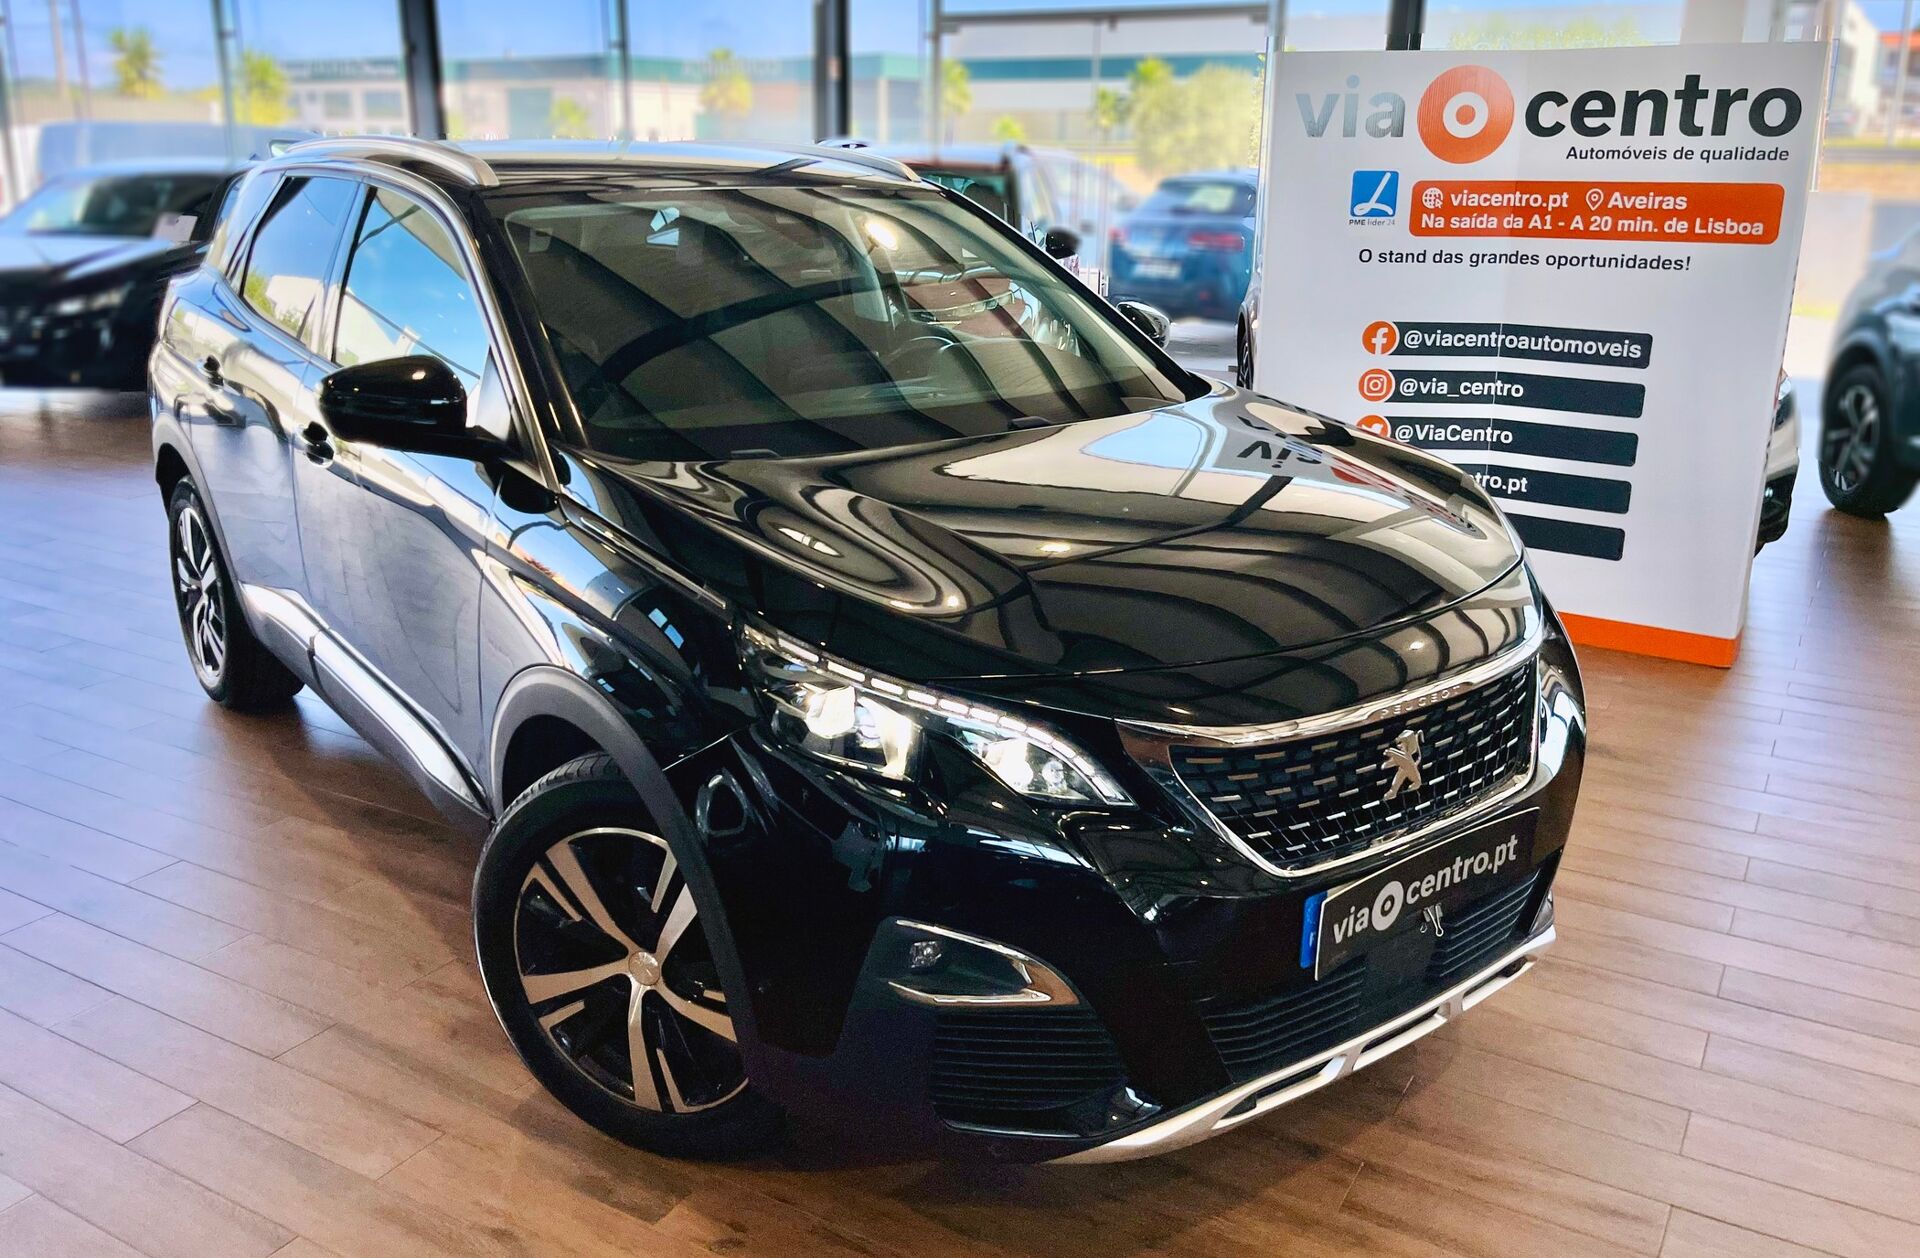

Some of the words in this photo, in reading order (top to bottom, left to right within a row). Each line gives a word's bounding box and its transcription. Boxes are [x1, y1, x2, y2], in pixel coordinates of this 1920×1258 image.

[1295, 74, 1406, 138] via
[1525, 74, 1802, 137] centro
[1566, 145, 1667, 160] Automóveis
[1673, 147, 1694, 160] de
[1700, 147, 1789, 163] qualidade
[1451, 190, 1569, 211] viacentro.pt
[1607, 192, 1688, 210] Aveiras
[1421, 213, 1445, 229] Na
[1450, 213, 1498, 229] saída
[1503, 215, 1523, 229] da
[1528, 215, 1553, 230] A1
[1570, 215, 1584, 231] A
[1589, 216, 1612, 232] 20
[1617, 217, 1658, 232] min.
[1664, 217, 1689, 233] de
[1695, 218, 1764, 235] Lisboa
[1358, 249, 1373, 263] O
[1378, 250, 1427, 264] stand
[1432, 251, 1464, 264] das
[1469, 251, 1540, 267] grandes
[1545, 253, 1691, 271] oportunidades!
[1403, 330, 1642, 358] @viacentroautomoveis
[1399, 377, 1524, 398] @via_centro
[1395, 425, 1513, 444] @ViaCentro
[1333, 906, 1369, 944] via
[1406, 834, 1519, 905] centro.pt
